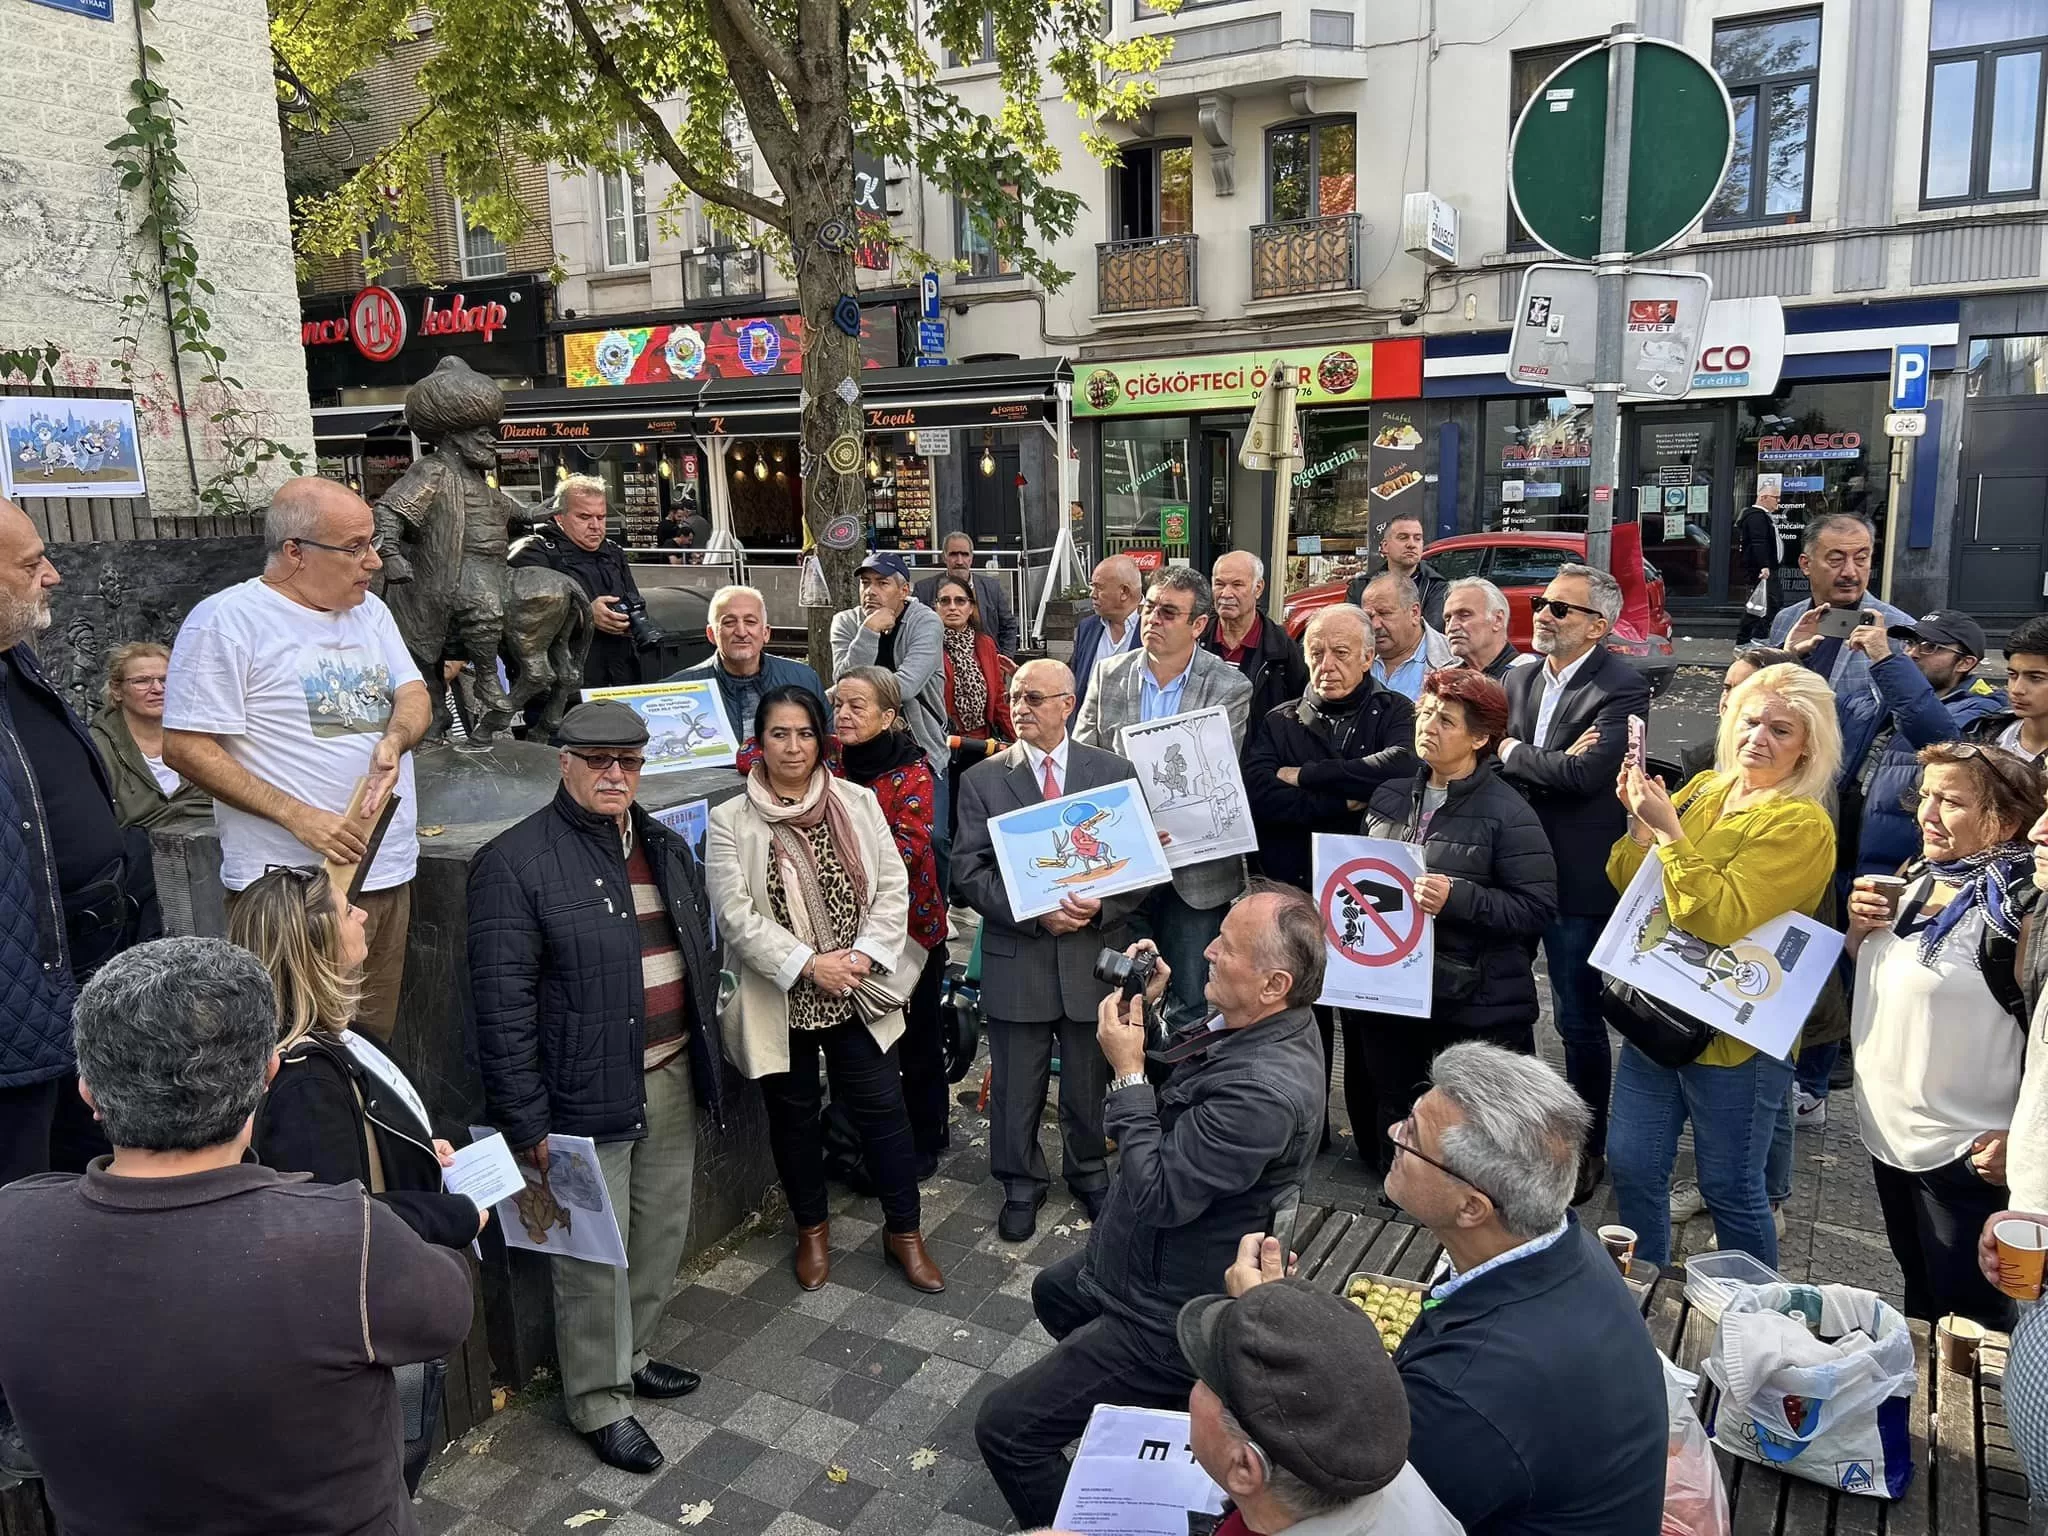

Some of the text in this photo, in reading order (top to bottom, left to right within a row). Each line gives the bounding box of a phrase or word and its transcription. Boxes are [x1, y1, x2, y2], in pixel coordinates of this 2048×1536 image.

[855, 172, 879, 210] K
[924, 279, 938, 311] P
[417, 293, 507, 342] kebap
[301, 318, 348, 345] nce
[1628, 324, 1673, 332] #EVET
[1125, 366, 1244, 400] ÇİĞKÖFTECİ
[1897, 353, 1924, 399] P
[867, 408, 916, 427] Koçak
[998, 405, 1028, 414] FORESTA
[501, 422, 590, 439] Pizzeria Koçak
[708, 417, 726, 434] K
[1760, 432, 1861, 450] FIMASCO
[1502, 442, 1592, 460] FIMASCO
[1292, 447, 1359, 489] egetarian
[1784, 480, 1808, 488] Crédits
